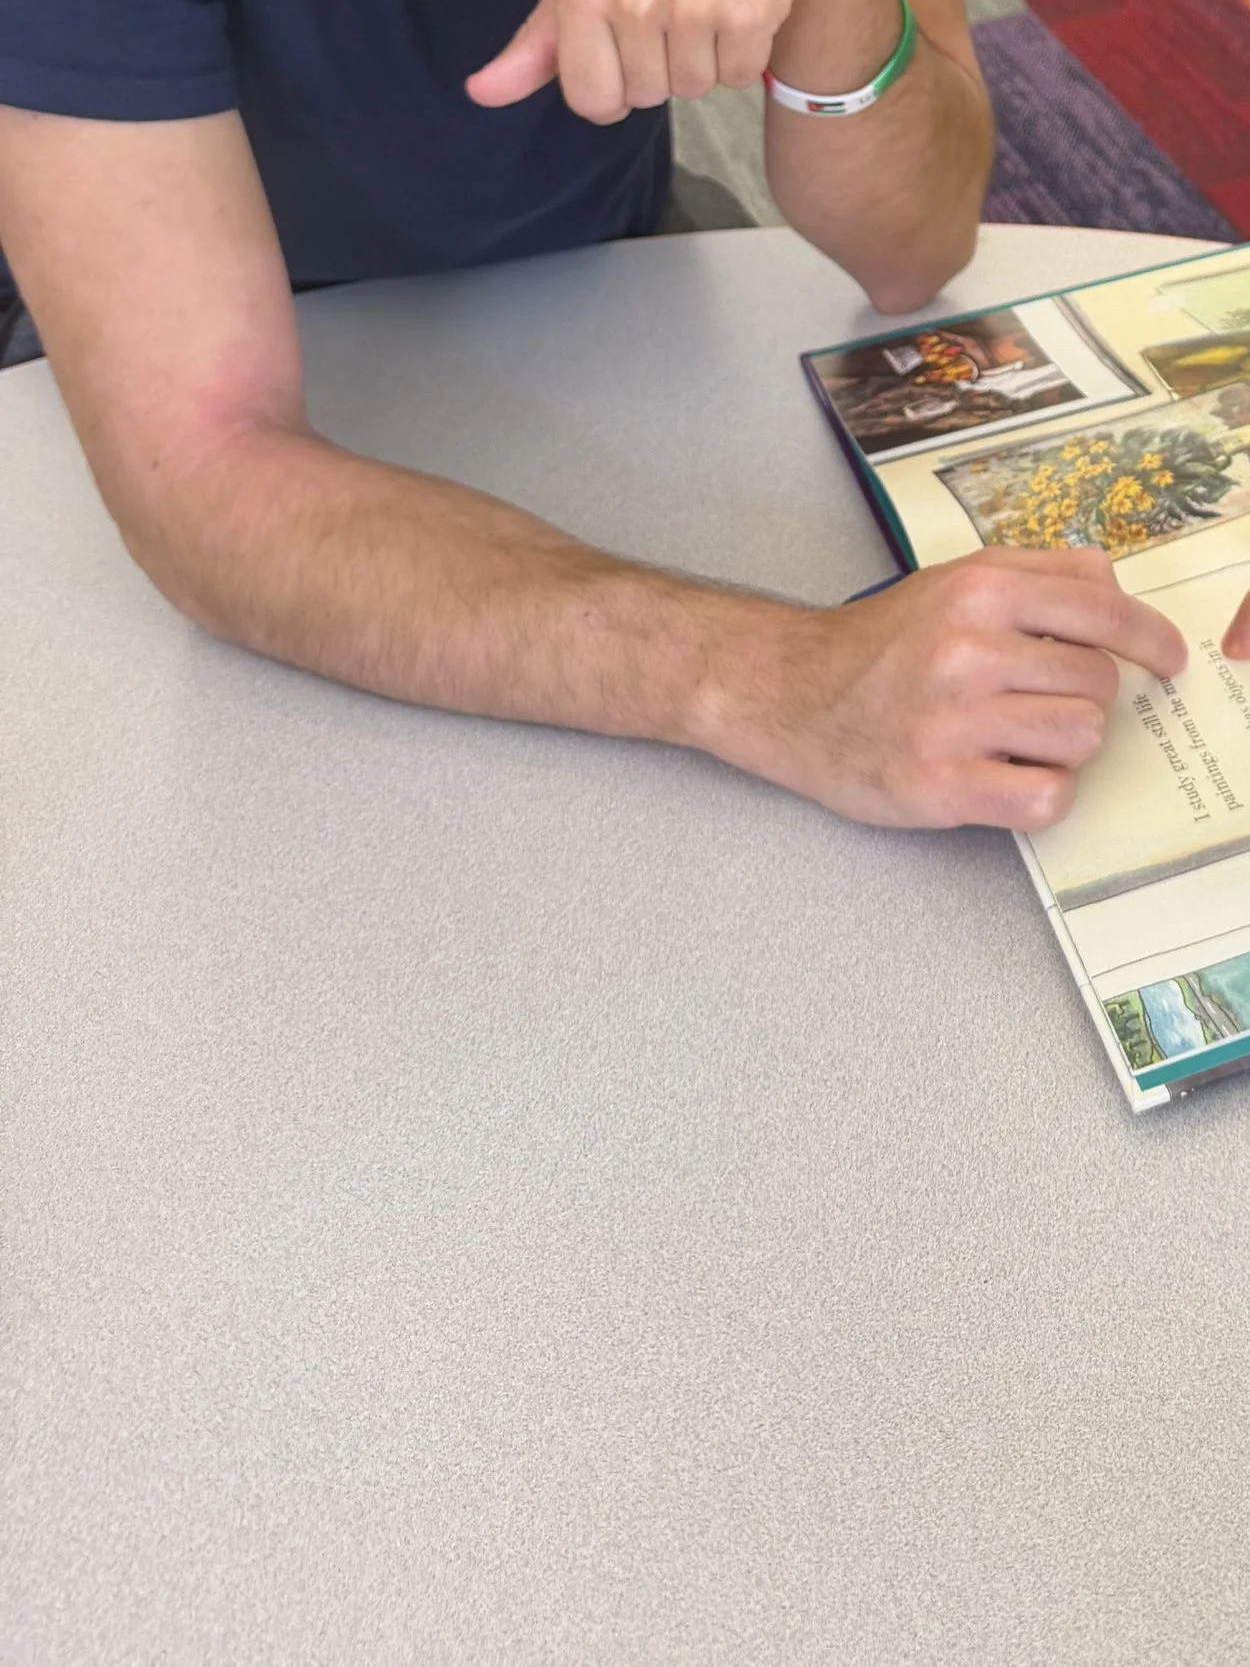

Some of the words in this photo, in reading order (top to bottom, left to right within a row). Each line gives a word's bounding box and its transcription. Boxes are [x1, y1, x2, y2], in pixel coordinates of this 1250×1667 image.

[1200, 638, 1214, 650] it
[1207, 650, 1223, 663] in
[1217, 664, 1247, 704] objects
[1133, 693, 1154, 714] life
[1171, 697, 1189, 718] the
[1142, 714, 1168, 739] still
[1182, 718, 1206, 750] from
[1159, 739, 1189, 773] great
[1200, 750, 1244, 811] paintings
[1177, 775, 1206, 812] study
[1194, 812, 1211, 823] I
